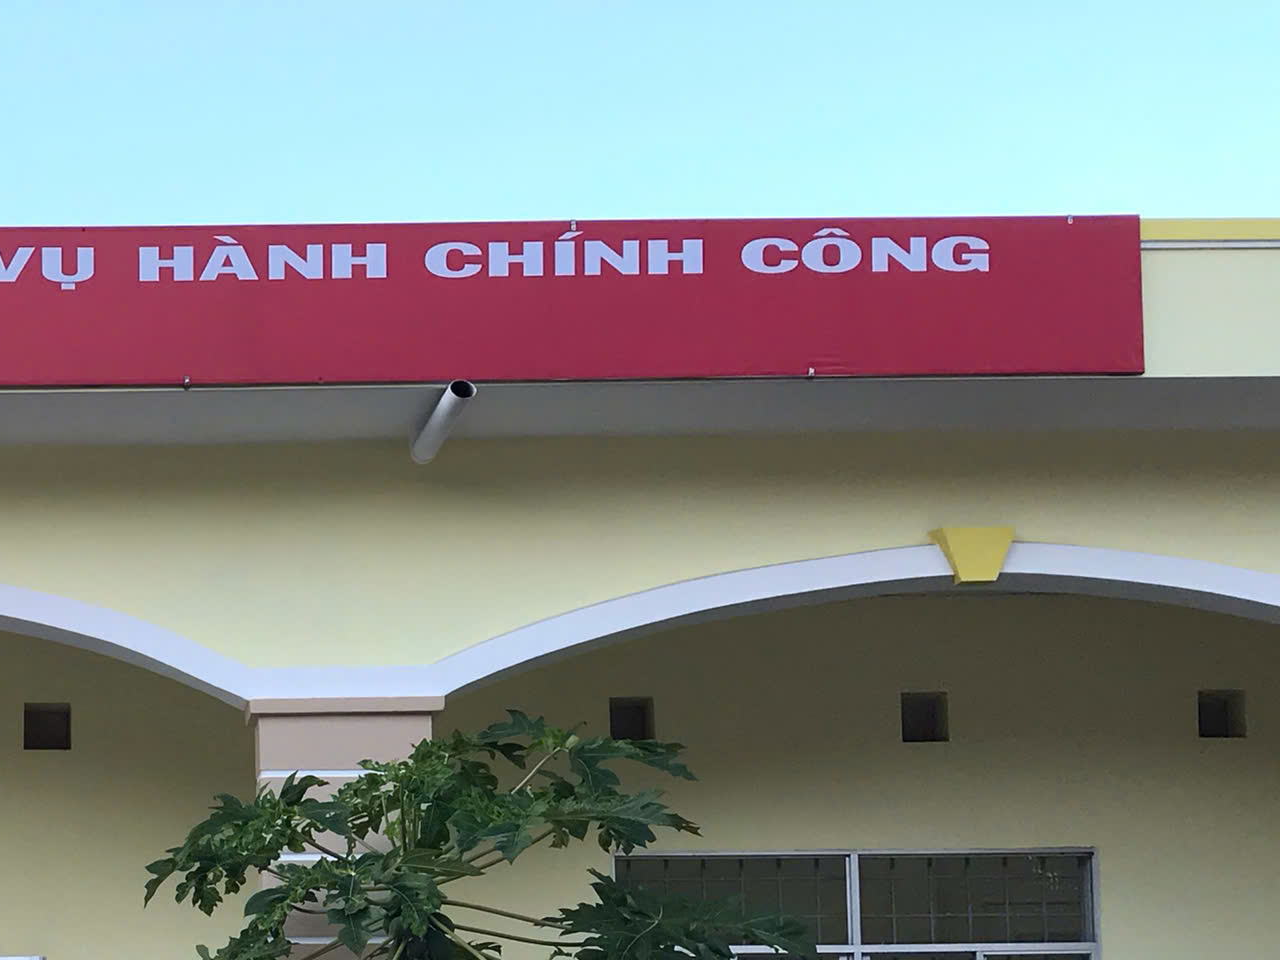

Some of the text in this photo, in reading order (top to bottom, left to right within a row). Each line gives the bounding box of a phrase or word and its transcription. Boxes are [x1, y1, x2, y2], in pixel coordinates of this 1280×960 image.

[139, 236, 387, 282] HÀNH
[425, 231, 704, 279] CHÍNH
[741, 227, 990, 274] CÔNG
